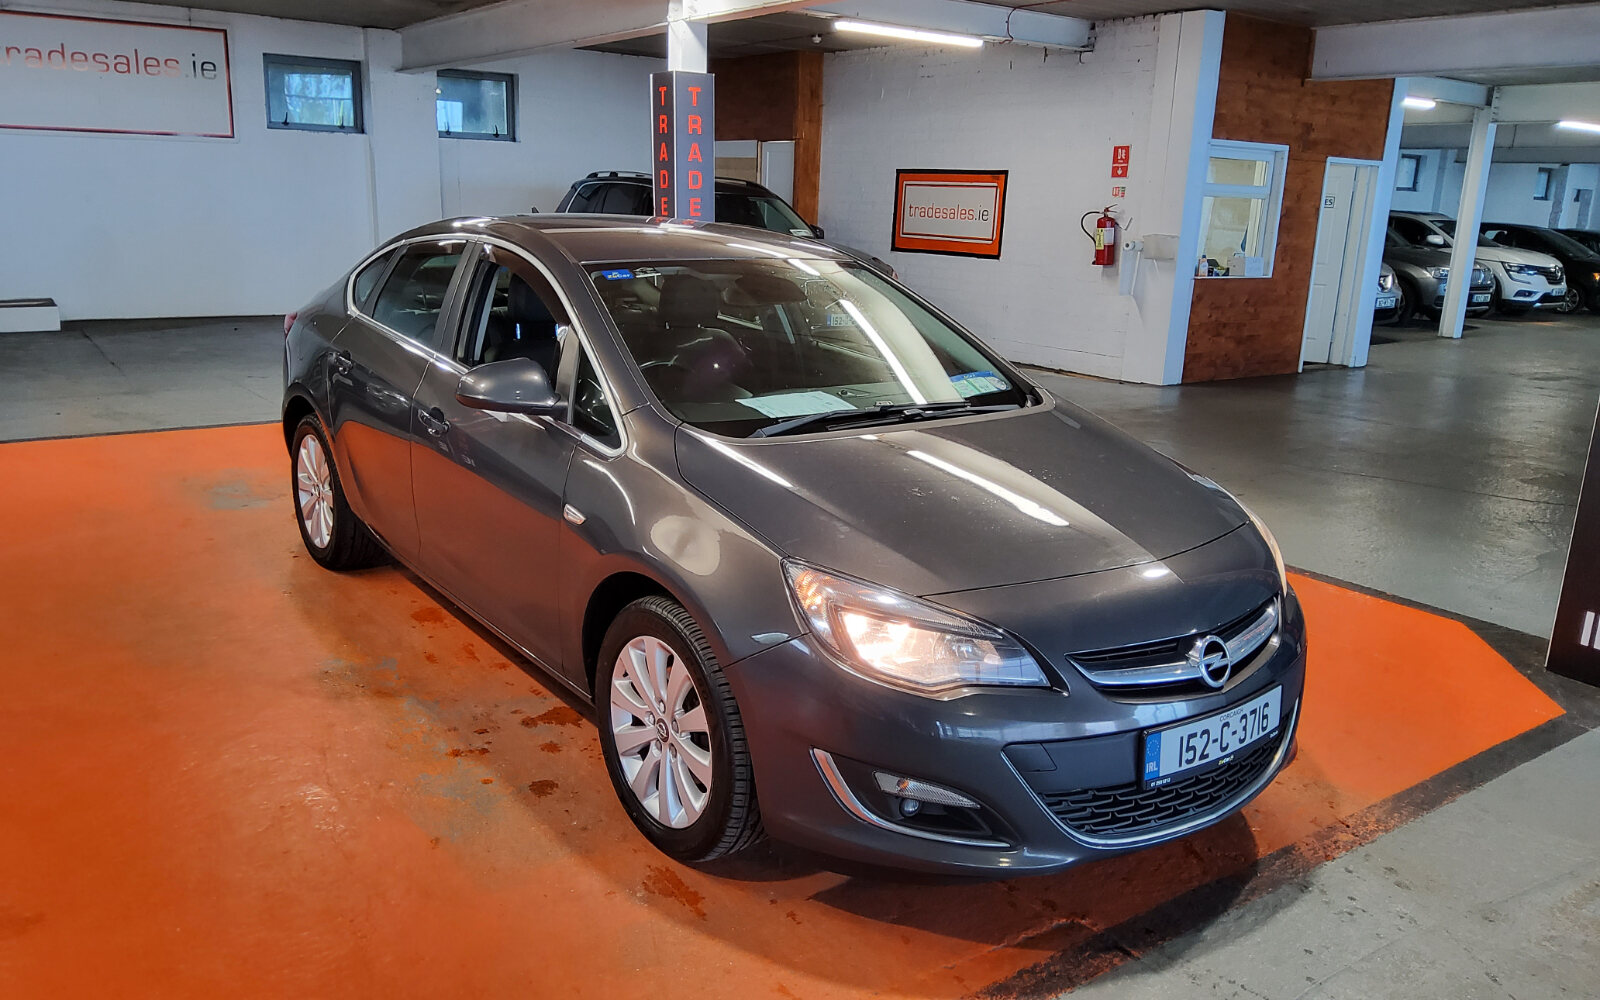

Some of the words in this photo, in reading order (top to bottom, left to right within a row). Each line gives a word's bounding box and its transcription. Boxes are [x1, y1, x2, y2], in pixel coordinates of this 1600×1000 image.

[0, 43, 217, 80] radesales.ie
[659, 86, 669, 216] TRADE
[688, 87, 702, 217] TRADE
[909, 203, 989, 222] tradesales.ie
[1178, 701, 1270, 768] 152-C-3716
[1146, 760, 1158, 774] IRL
